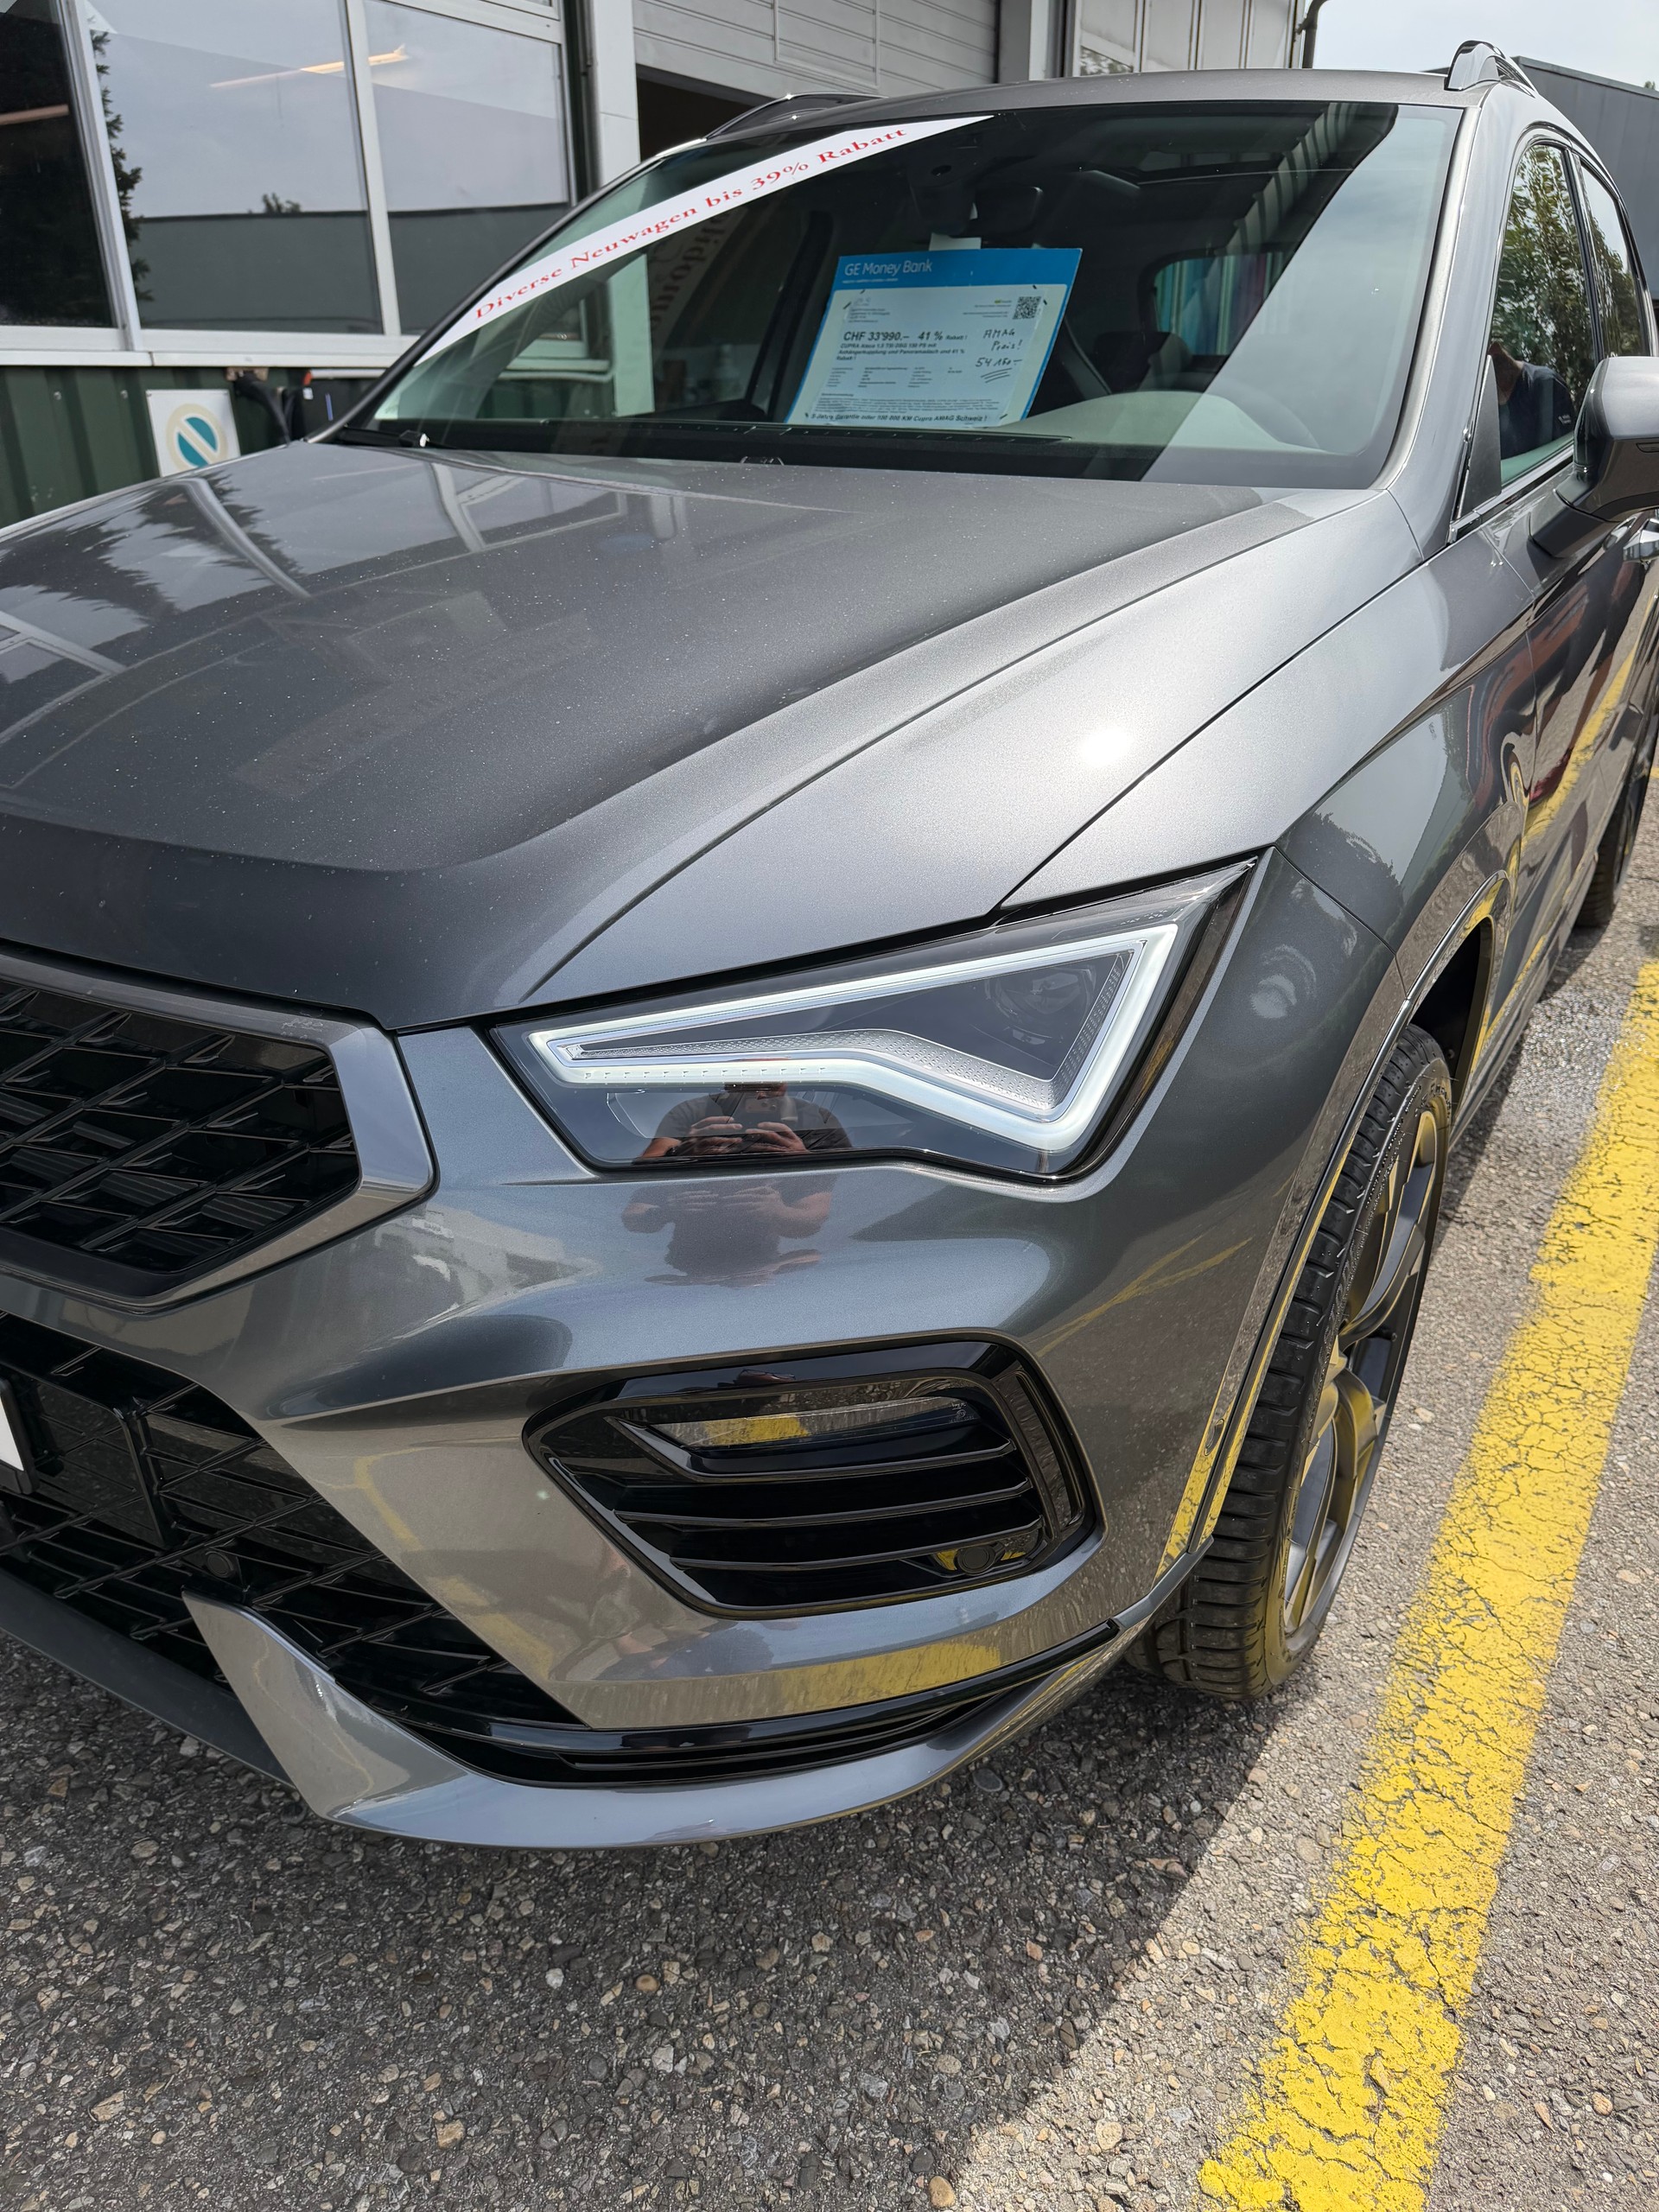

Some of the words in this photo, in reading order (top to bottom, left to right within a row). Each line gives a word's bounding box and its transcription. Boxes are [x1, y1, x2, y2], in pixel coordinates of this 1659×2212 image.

[475, 267, 563, 319] Diverse
[570, 207, 697, 270] Neuwagen
[705, 188, 743, 207] bis
[751, 162, 809, 191] 39%
[817, 129, 907, 163] Rabatt
[844, 263, 861, 276] GE
[862, 262, 901, 276] Money
[903, 258, 932, 273] Bank
[843, 331, 866, 341] CHF
[918, 331, 931, 340] 41
[934, 330, 944, 340] %
